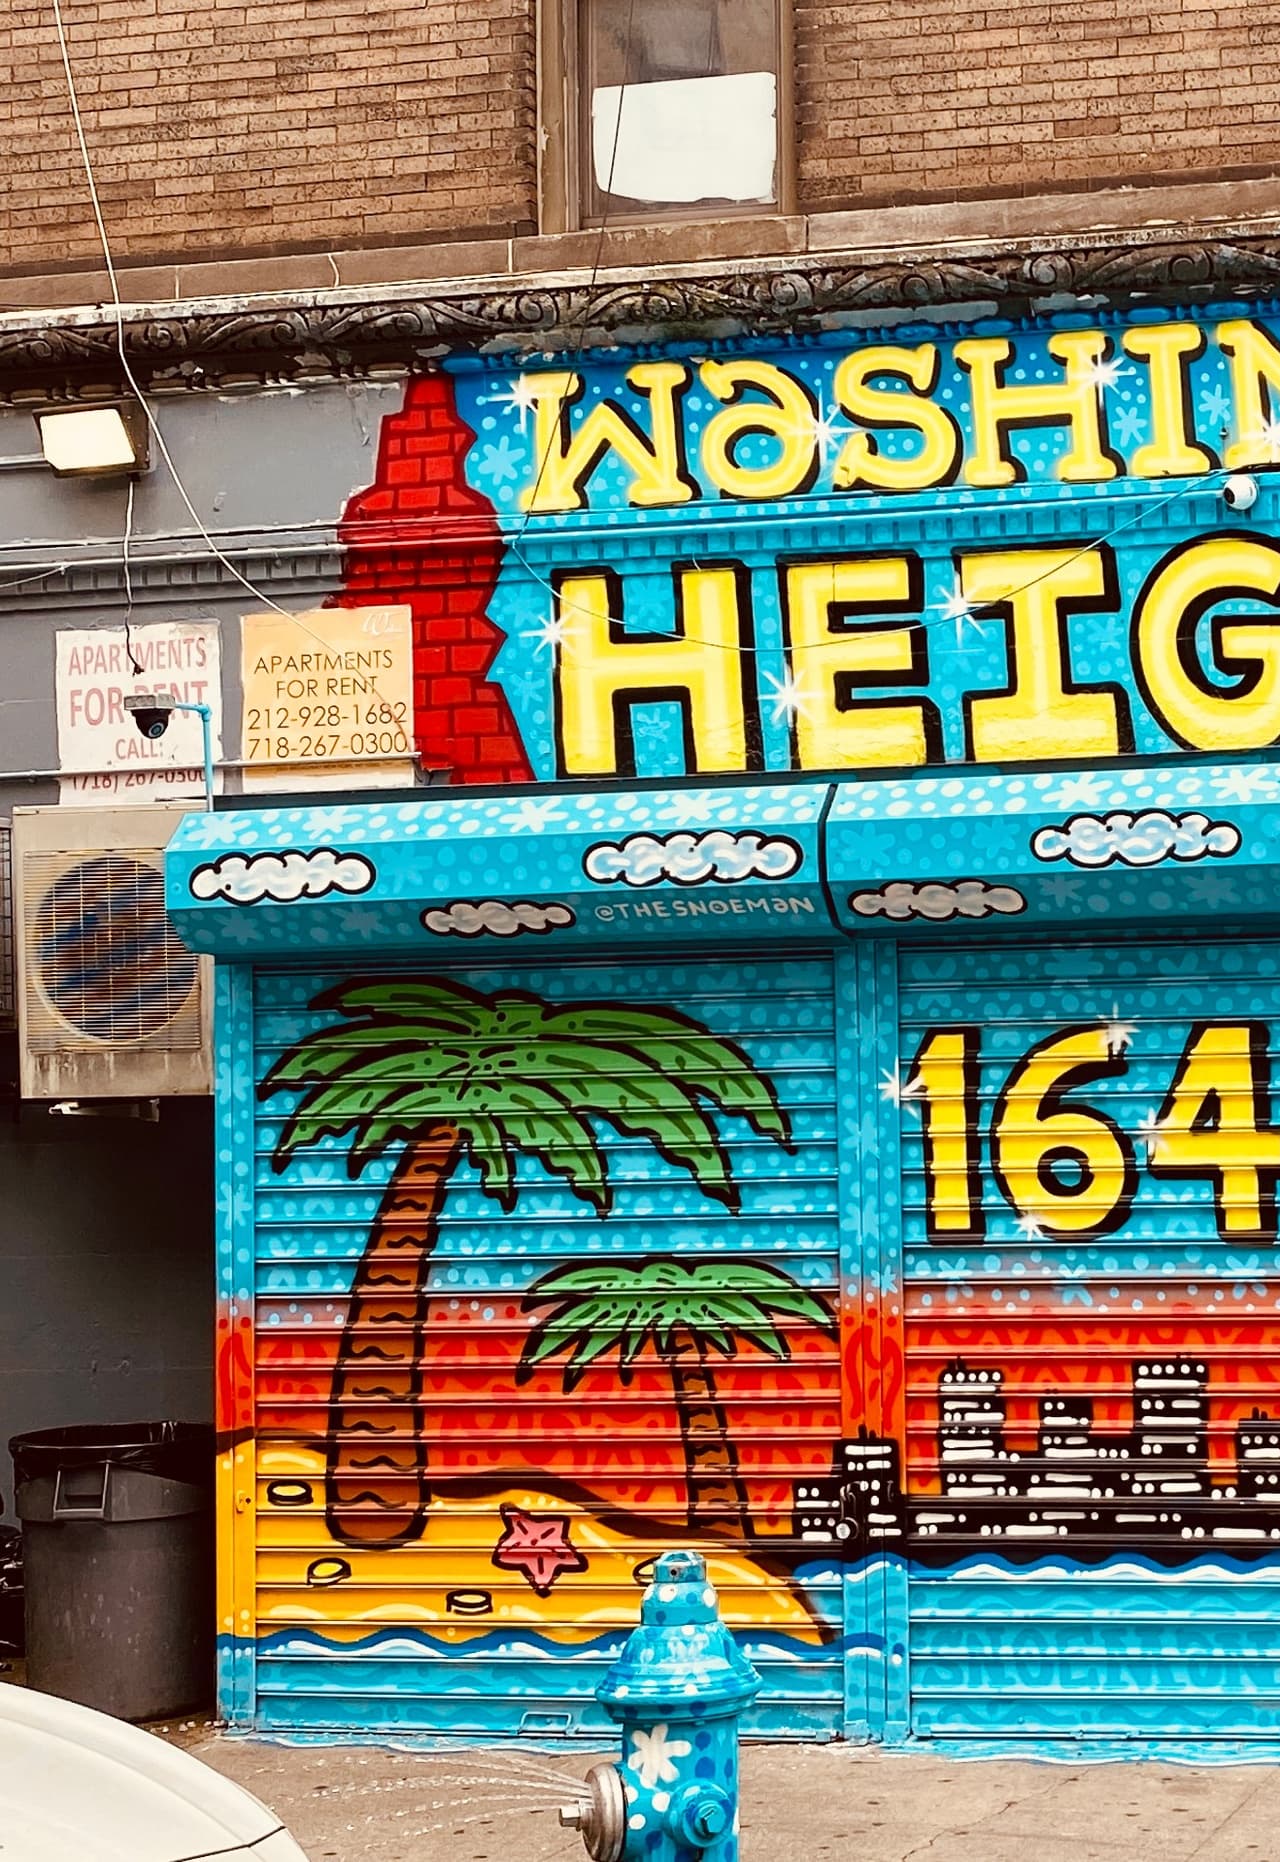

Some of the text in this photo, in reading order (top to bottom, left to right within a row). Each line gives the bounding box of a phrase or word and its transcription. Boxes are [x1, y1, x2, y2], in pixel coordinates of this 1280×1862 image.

[68, 637, 208, 677] APARTMENTS
[253, 649, 394, 675] APARTMENTS
[276, 675, 378, 699] FOR RENT
[69, 686, 125, 728] FOR
[247, 701, 408, 731] 212-928-1682
[247, 731, 408, 760] 718-267-0300
